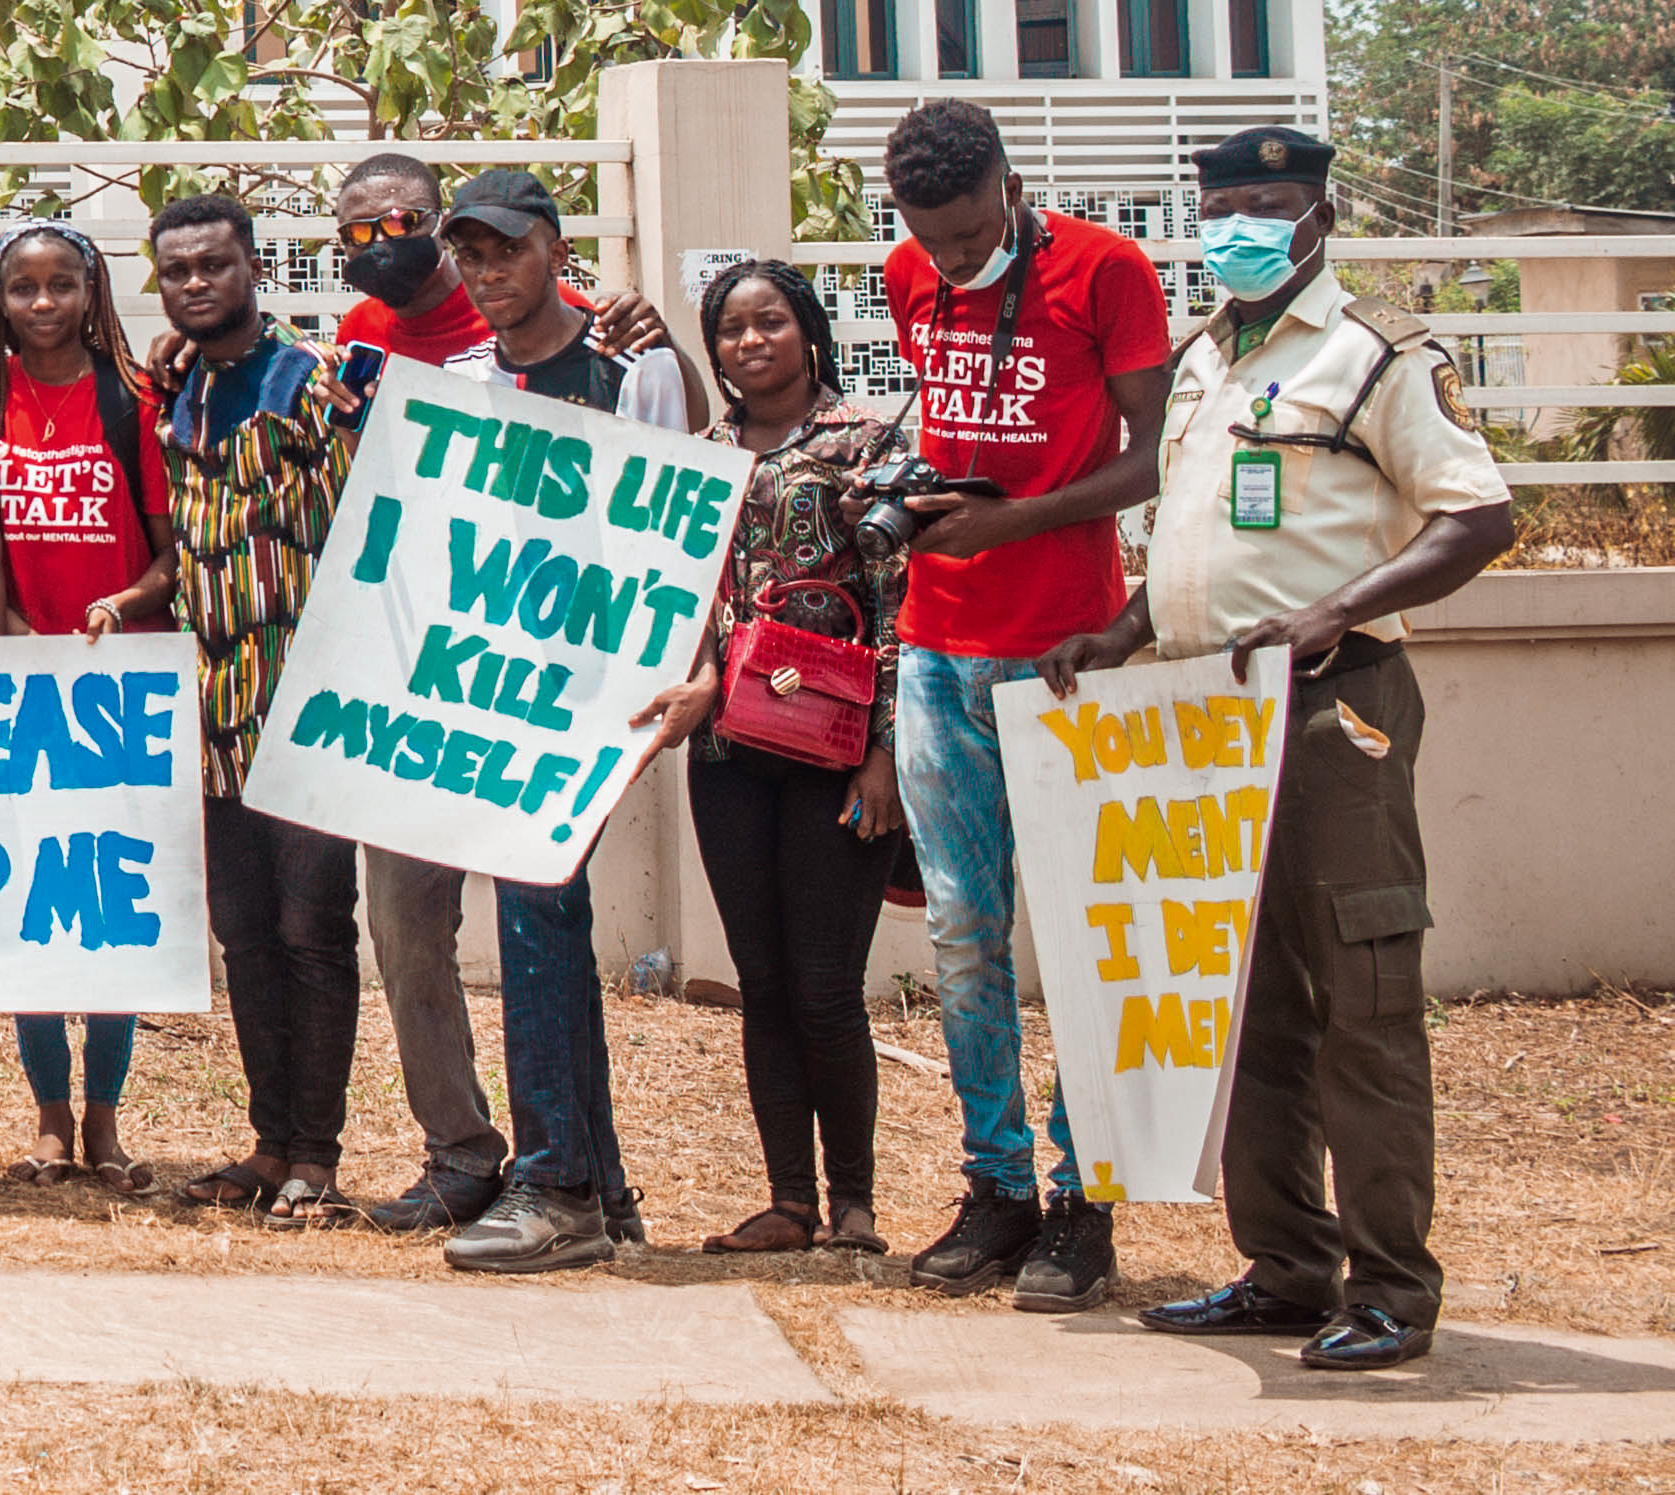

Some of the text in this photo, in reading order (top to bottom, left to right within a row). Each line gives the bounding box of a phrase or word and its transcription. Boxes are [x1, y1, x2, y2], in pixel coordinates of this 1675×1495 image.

[1003, 293, 1017, 319] EOS
[936, 329, 1034, 349] #stopthesma
[923, 349, 1046, 392] LET'S
[928, 386, 1036, 427] TALK
[957, 429, 999, 443] MENTAL
[1001, 432, 1048, 443] HEALTH
[404, 398, 732, 560] THIS LIFE
[0, 494, 109, 527] TALK
[42, 532, 81, 543] MENTAL
[83, 533, 117, 543] HEALTH
[351, 495, 699, 668] I WON'T
[407, 624, 575, 732] KILL
[290, 690, 624, 844] MYSELF!
[1036, 695, 1276, 785] YOU DEY
[20, 831, 161, 950] ME
[1086, 903, 1140, 982] I
